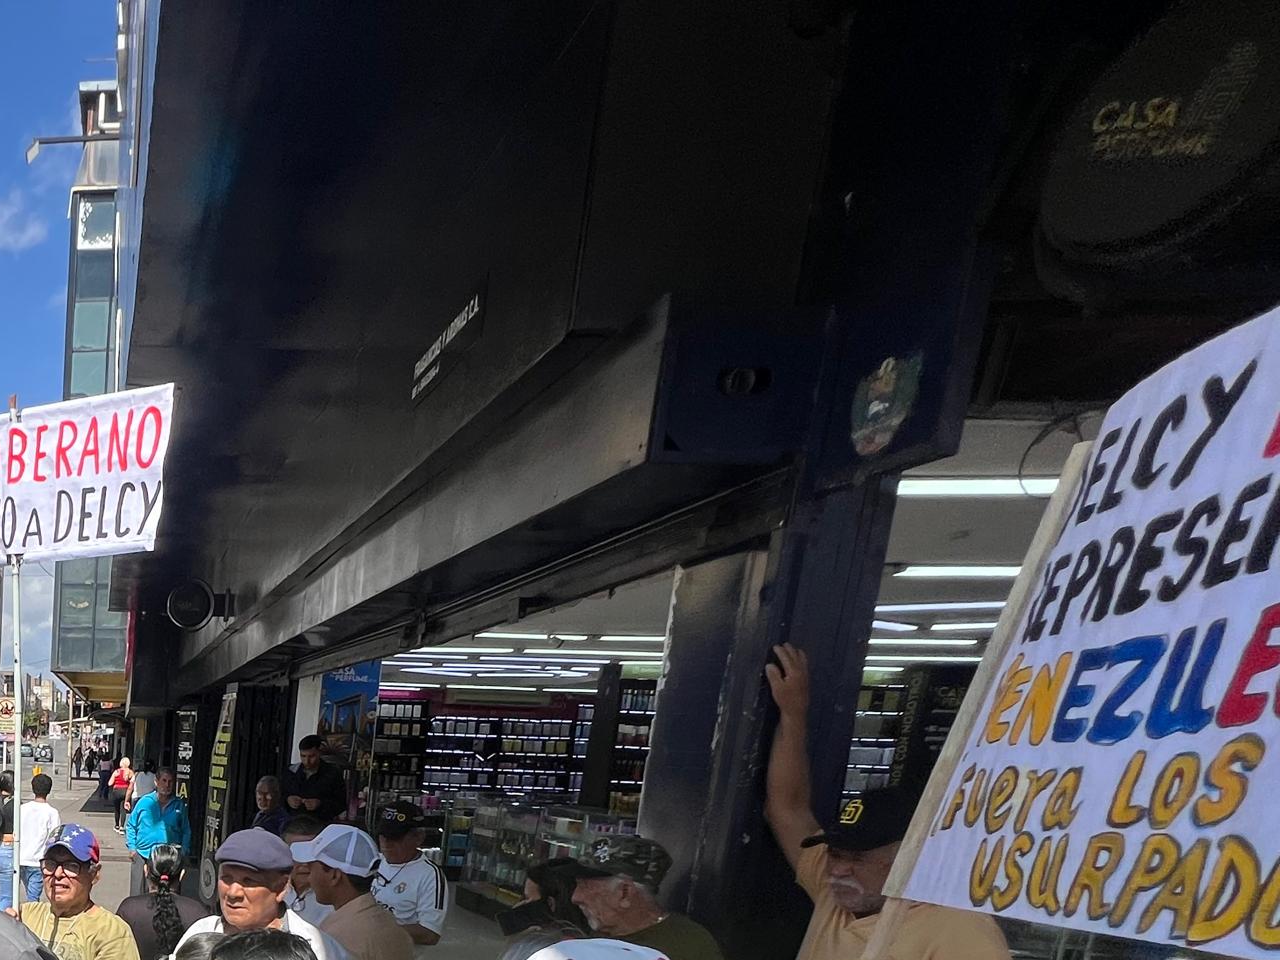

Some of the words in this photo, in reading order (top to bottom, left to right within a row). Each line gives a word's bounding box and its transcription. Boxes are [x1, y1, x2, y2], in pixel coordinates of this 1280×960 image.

[1056, 358, 1258, 546] ELCY
[22, 508, 43, 548] A
[53, 480, 163, 544] DELCY
[1106, 731, 1266, 829] LOS
